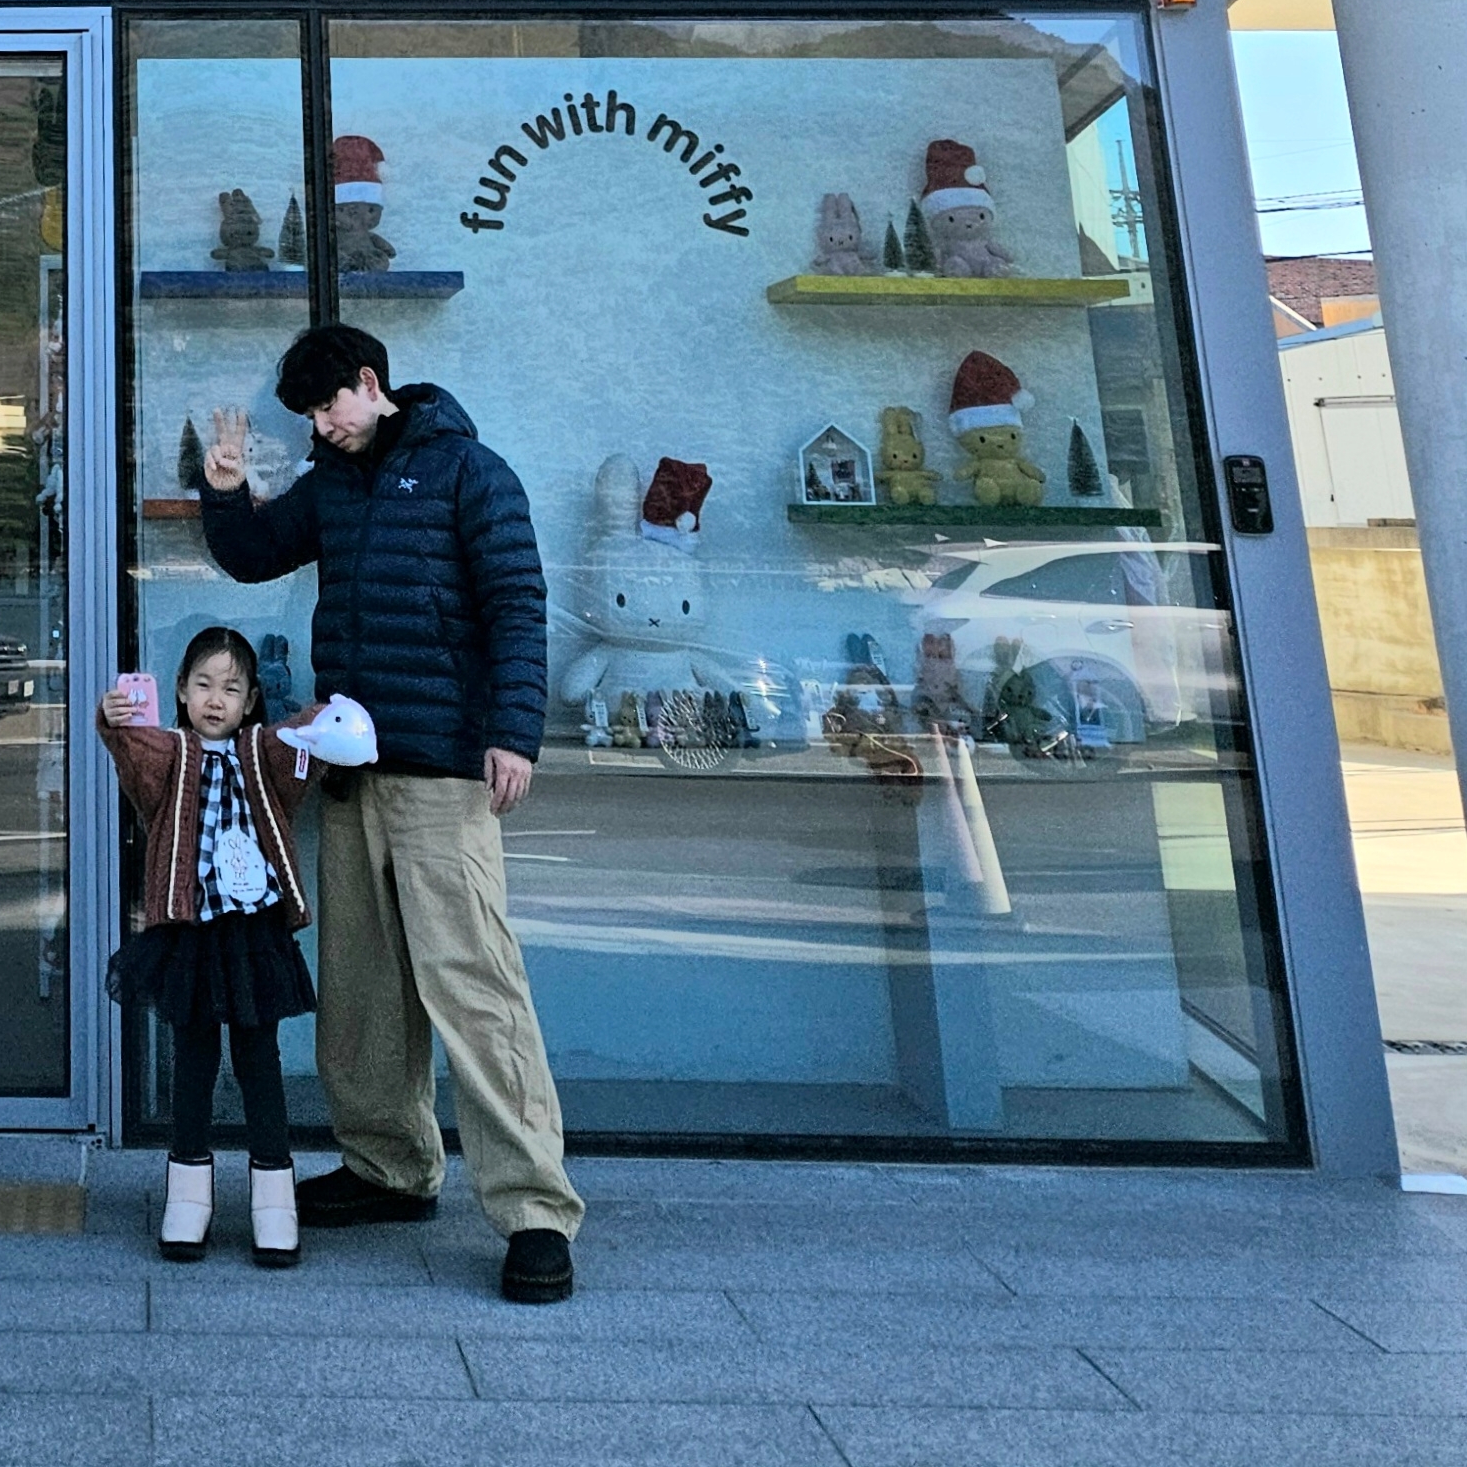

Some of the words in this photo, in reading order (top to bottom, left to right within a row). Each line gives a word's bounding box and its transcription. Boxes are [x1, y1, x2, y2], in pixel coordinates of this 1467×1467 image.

[460, 144, 528, 234] fun
[521, 90, 636, 149] with
[647, 113, 754, 237] miffy
